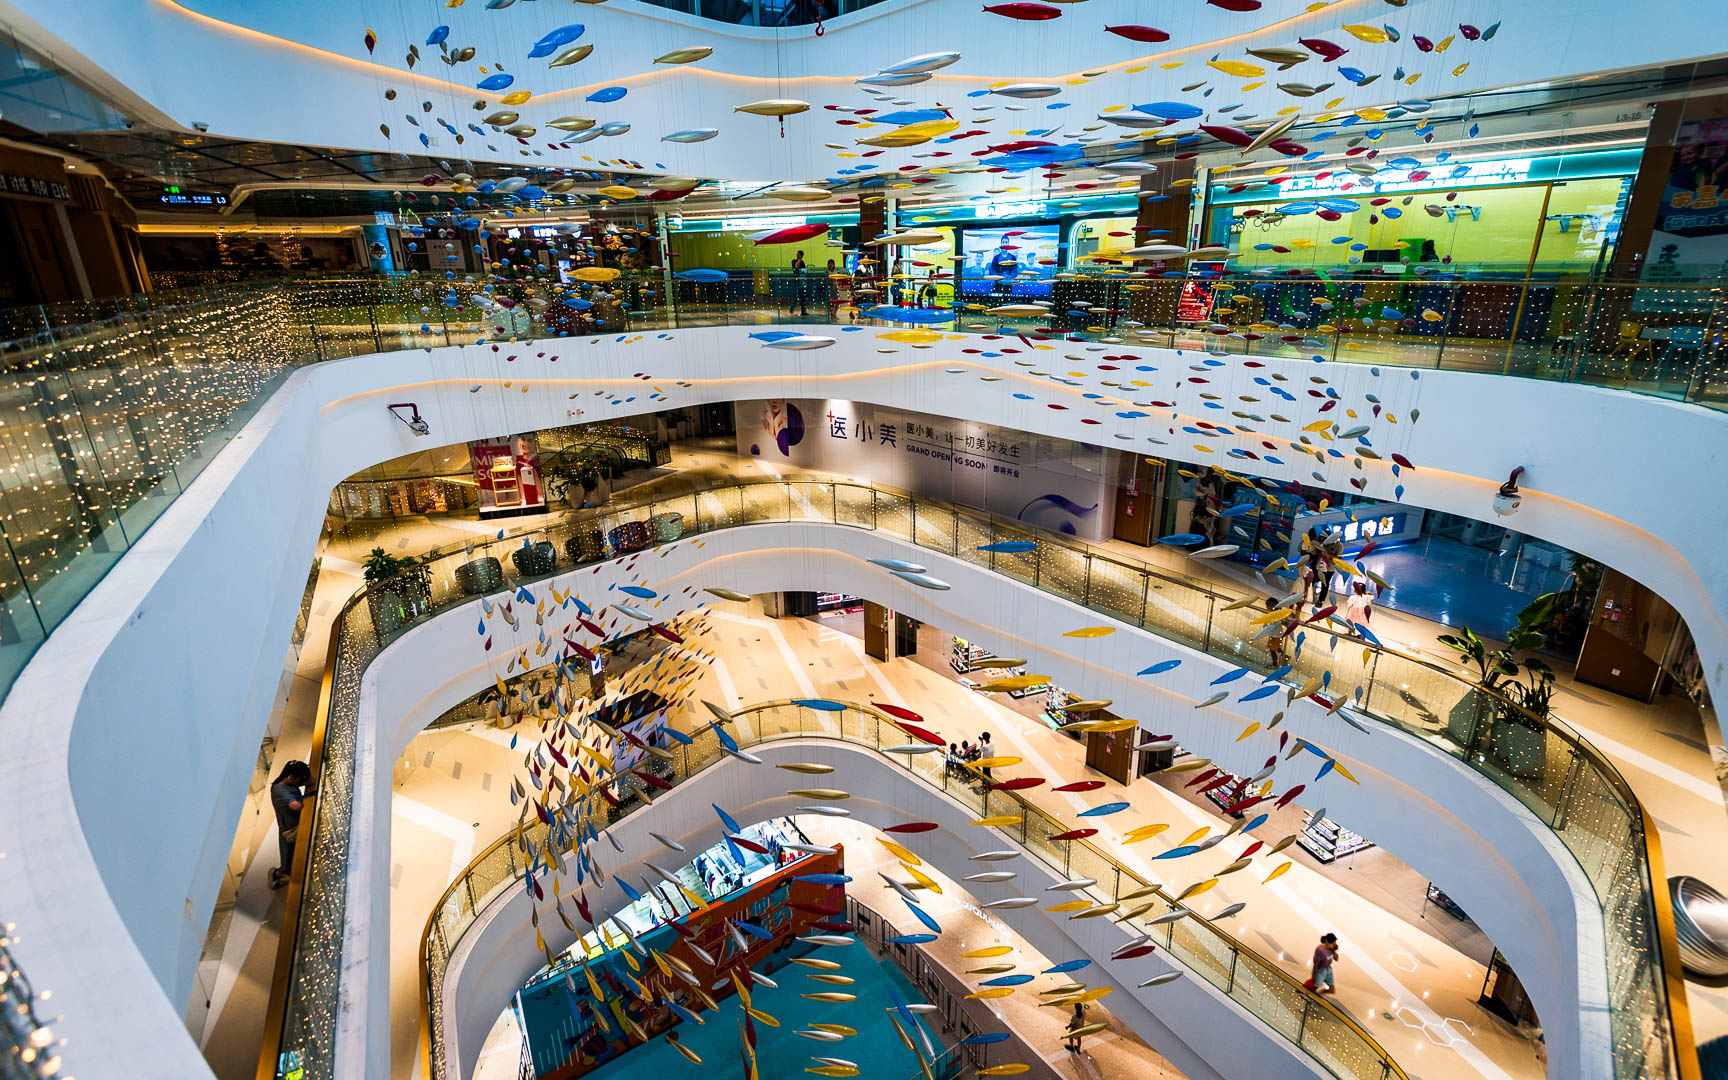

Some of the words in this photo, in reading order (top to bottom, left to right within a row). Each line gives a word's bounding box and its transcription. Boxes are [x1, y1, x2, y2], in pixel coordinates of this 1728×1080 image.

[827, 410, 896, 448] 医小美
[906, 444, 930, 457] GRAND
[931, 450, 963, 465] OPENNG
[964, 458, 987, 470] SOON
[993, 465, 1020, 478] 即将开业
